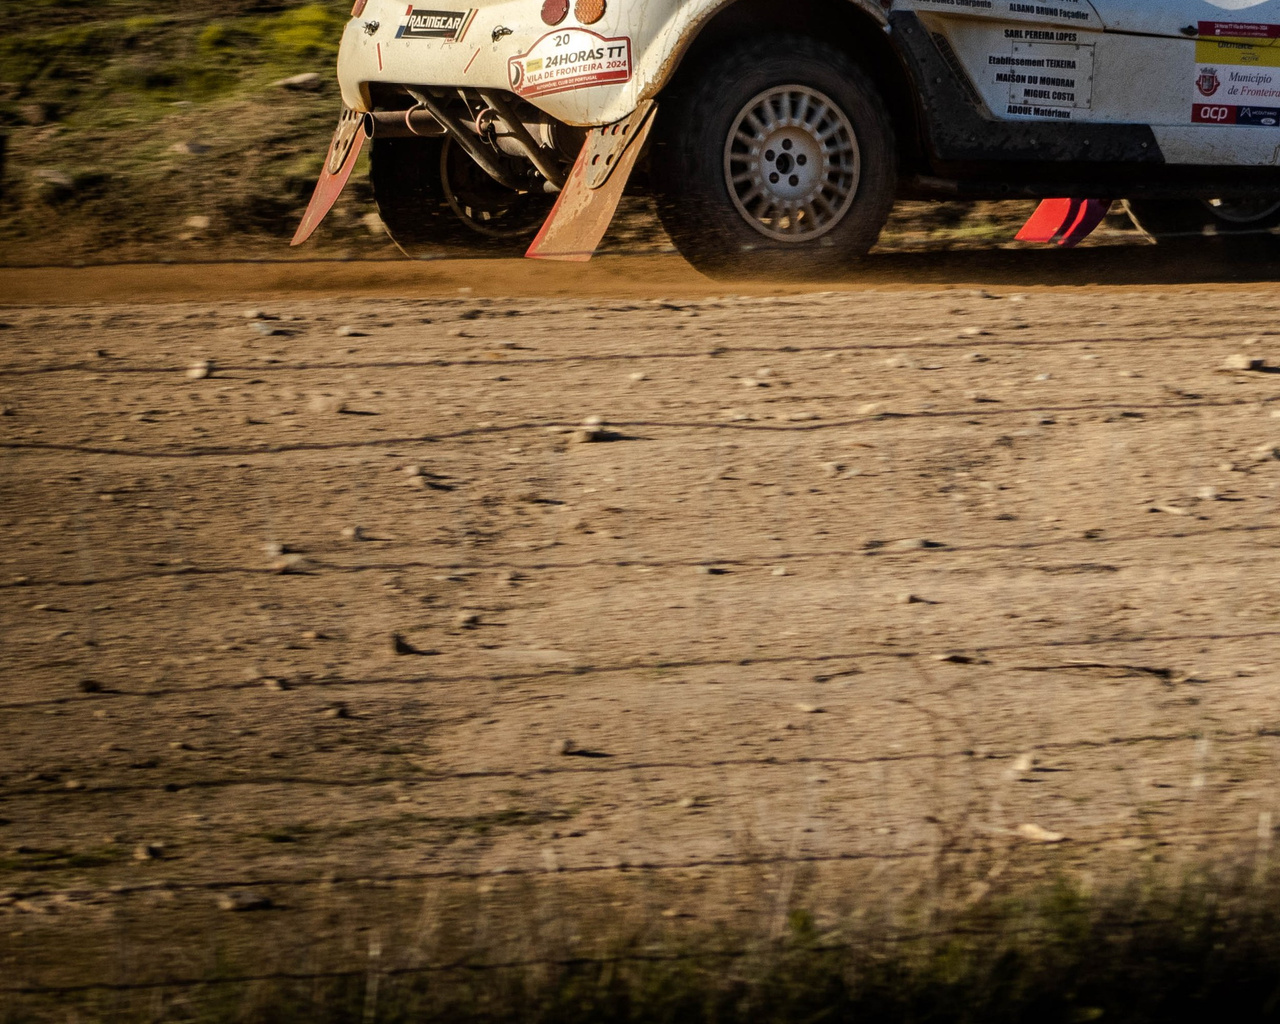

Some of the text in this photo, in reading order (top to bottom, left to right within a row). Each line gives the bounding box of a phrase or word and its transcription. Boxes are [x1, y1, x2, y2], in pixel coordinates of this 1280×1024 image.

[1009, 3, 1089, 20] ALBANO BRUNO Façadier
[408, 15, 461, 30] RACINGCAR
[555, 33, 570, 47] 20
[1004, 29, 1077, 42] SARL PEREIRA LOPES
[545, 45, 625, 68] 24HORAS TT
[988, 55, 1076, 70] Etablissement TEIXEIRA
[526, 60, 627, 84] VILA DE FRONTEIRA 2024
[574, 75, 598, 84] PORTUGAL
[1228, 71, 1272, 86] Município
[996, 73, 1075, 88] MAISON DU MONDRAN
[1024, 88, 1075, 102] MIGUEL COSTA
[1227, 85, 1280, 98] de Fronteira
[1007, 105, 1071, 118] ADOUE Matériaux
[1200, 106, 1228, 122] acp
